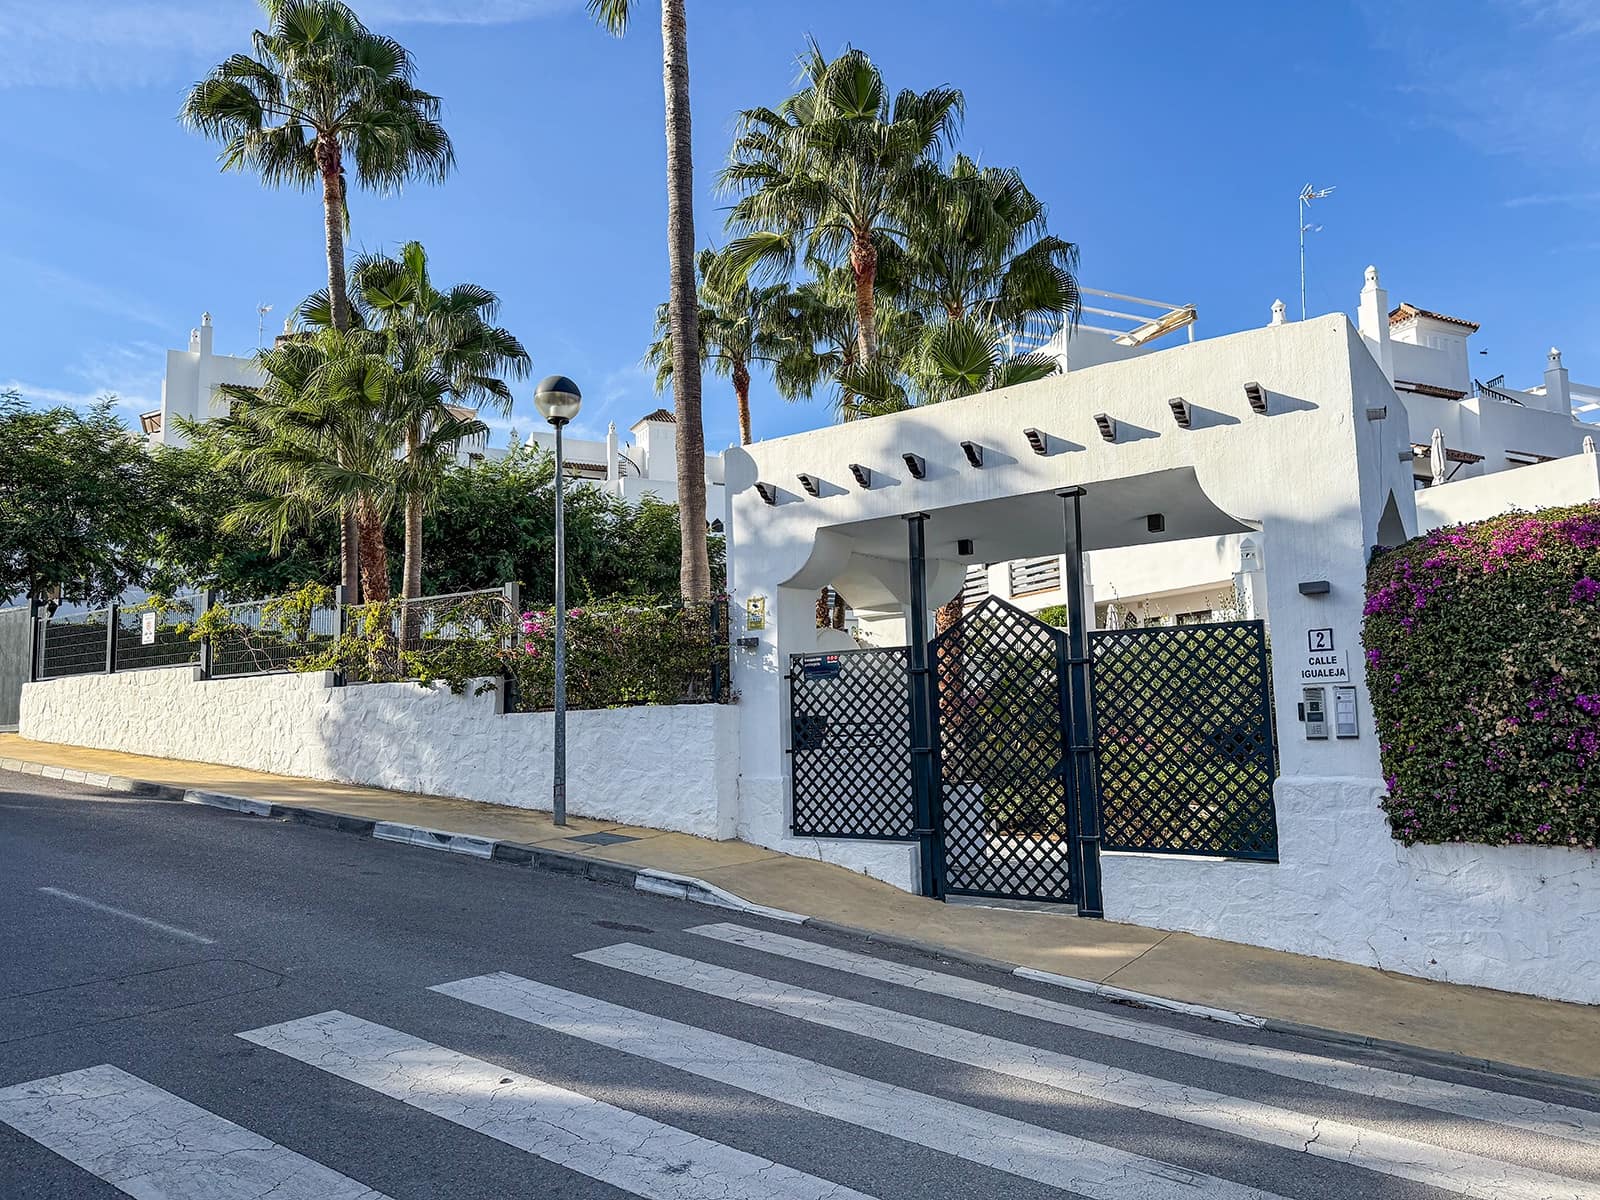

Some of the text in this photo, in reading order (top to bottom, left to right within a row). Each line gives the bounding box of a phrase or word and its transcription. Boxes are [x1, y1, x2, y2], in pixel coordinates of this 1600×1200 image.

[1316, 631, 1325, 648] 2
[1308, 655, 1337, 665] CALLE
[1301, 668, 1346, 678] IGUALEJA
